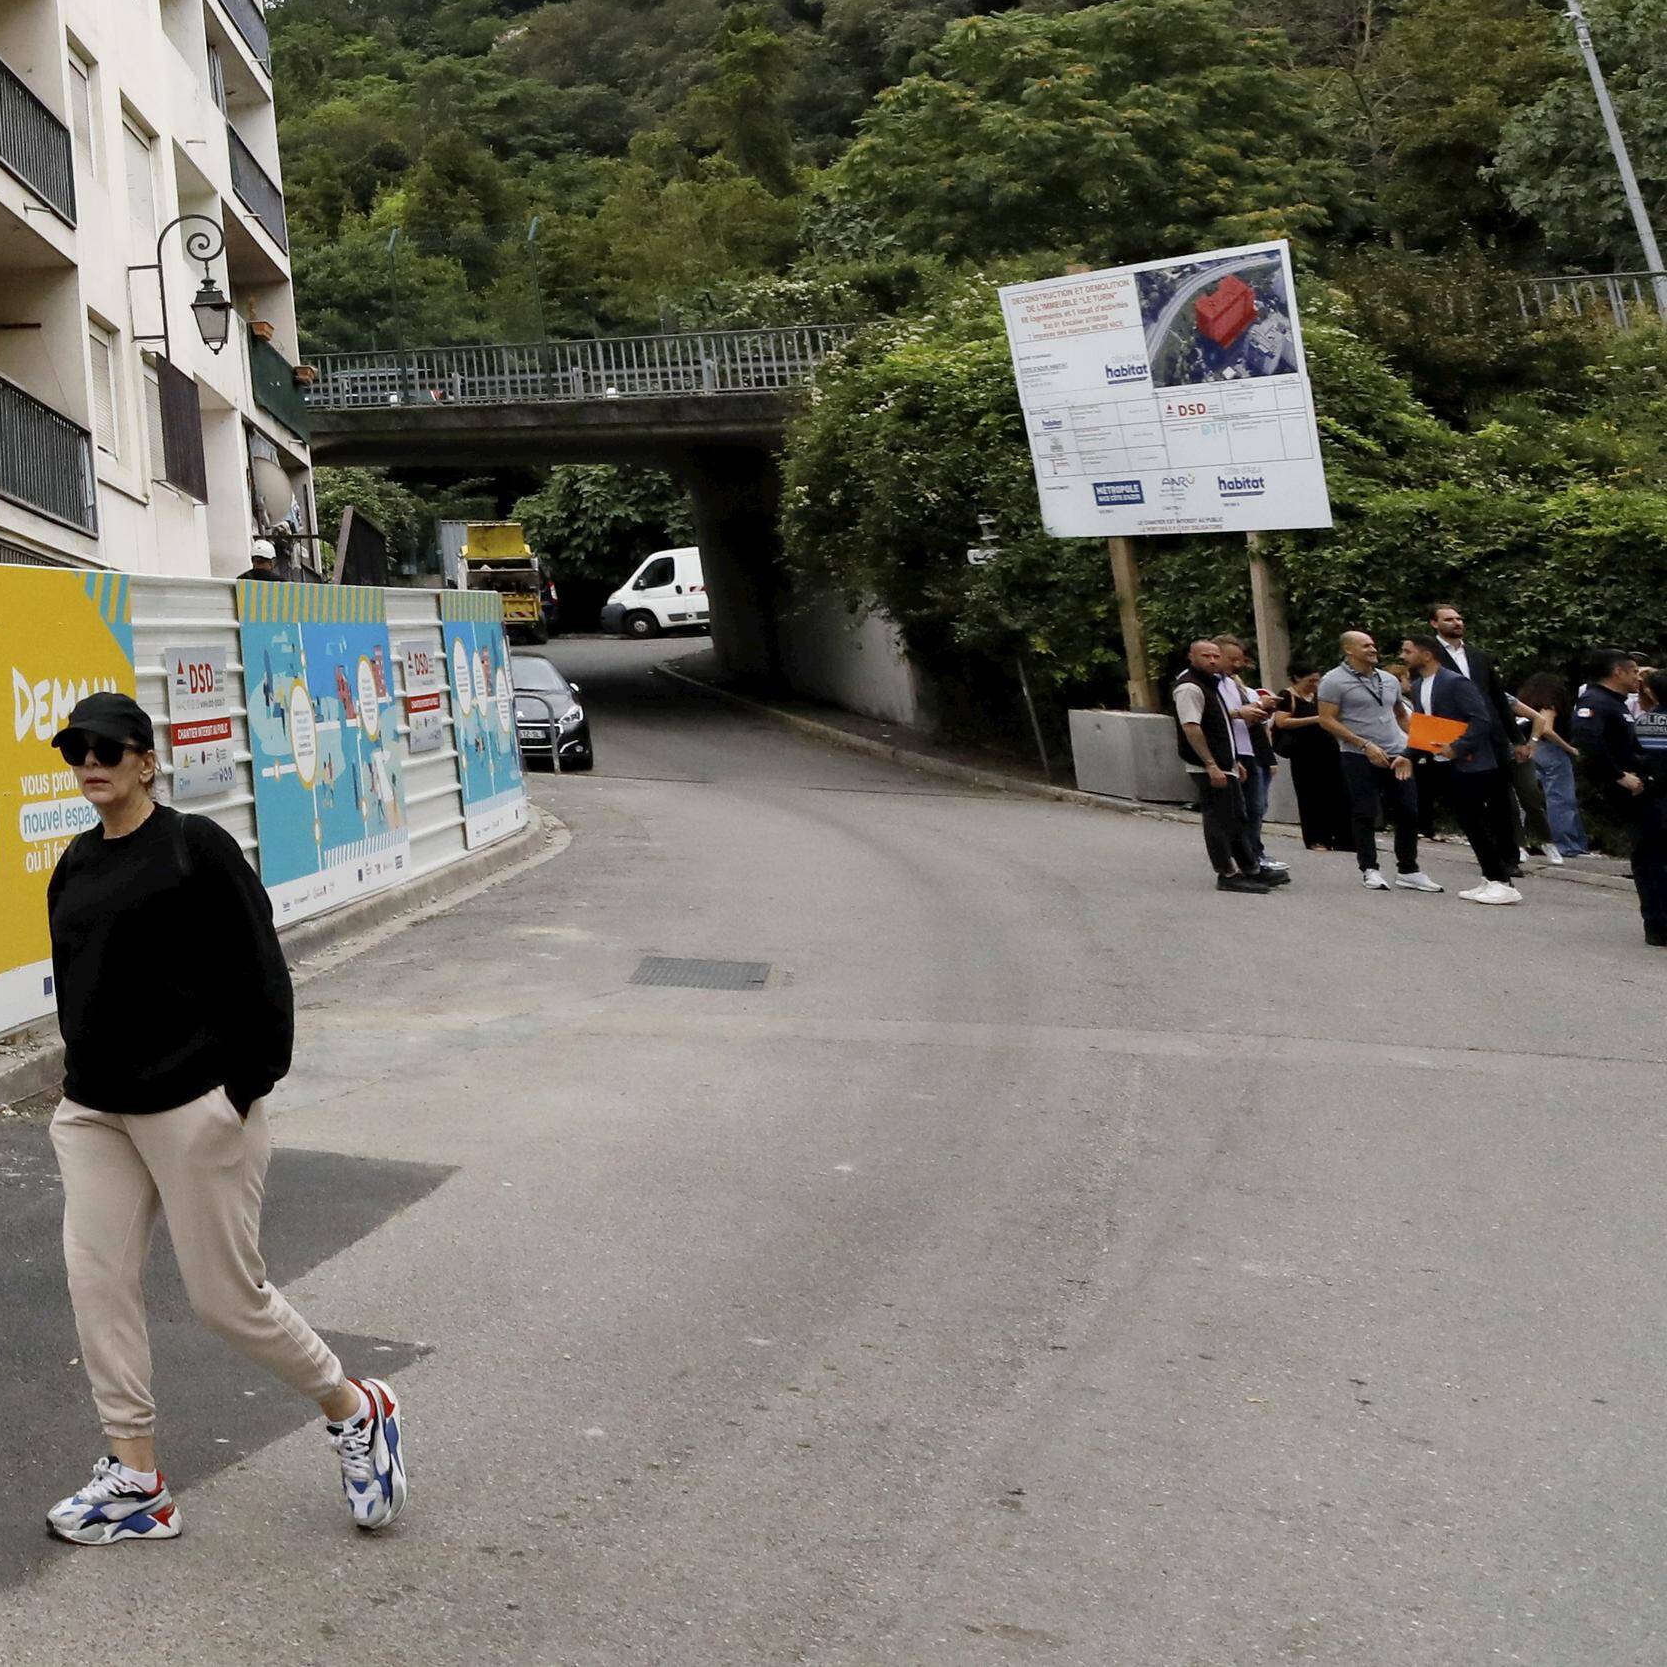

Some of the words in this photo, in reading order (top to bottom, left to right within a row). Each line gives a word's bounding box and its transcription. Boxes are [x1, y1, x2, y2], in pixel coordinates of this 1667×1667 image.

[1105, 364, 1147, 379] habitat
[1178, 403, 1206, 416] DSD
[1218, 476, 1265, 490] habitat
[189, 663, 214, 694] DSD
[12, 666, 117, 742] DEM
[1637, 714, 1667, 726] OLIC
[20, 773, 49, 797] vous
[23, 803, 61, 834] nouvel
[65, 804, 102, 832] espac
[26, 841, 42, 873] où
[44, 841, 51, 868] il
